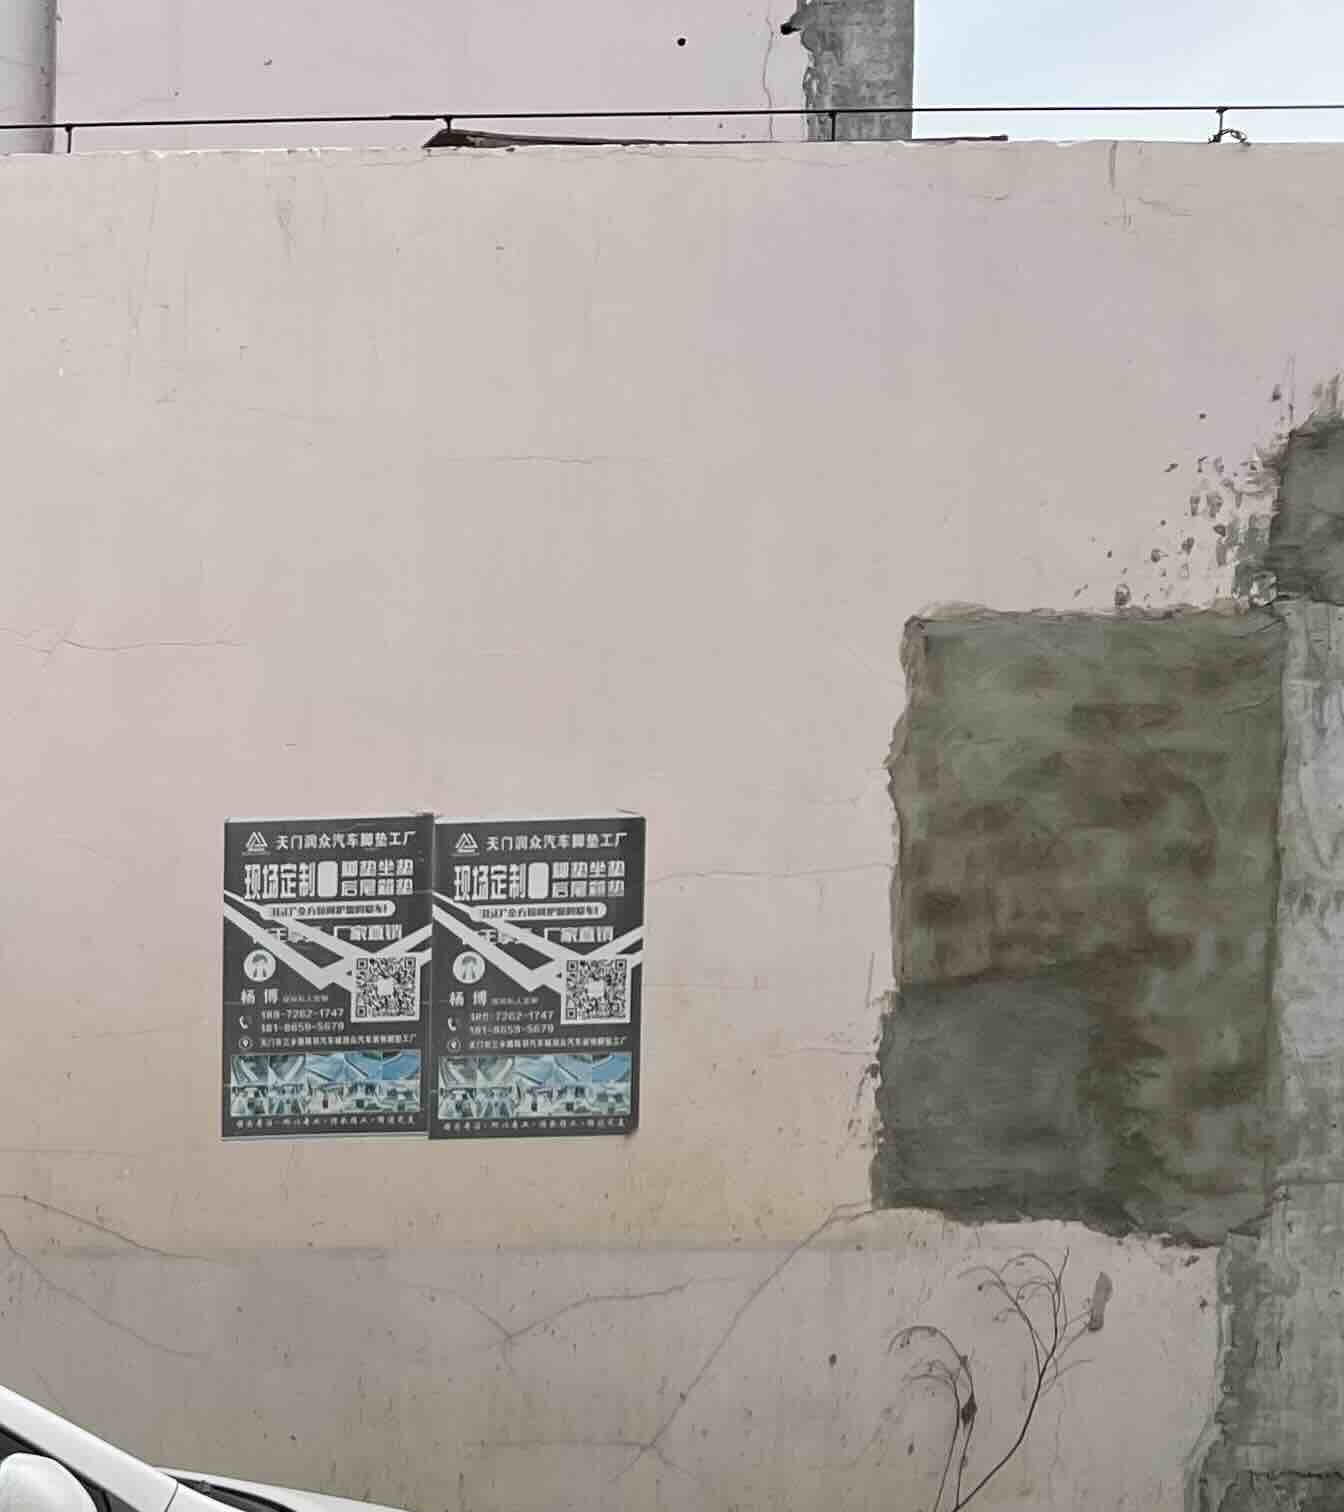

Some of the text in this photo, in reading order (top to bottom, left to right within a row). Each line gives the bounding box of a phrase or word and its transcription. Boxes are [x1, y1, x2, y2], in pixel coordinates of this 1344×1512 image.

[275, 830, 417, 850] 天门润众汽车脚垫工厂
[485, 832, 628, 851] 天门润众汽车脚垫工厂
[244, 861, 316, 900] 现场定制
[453, 863, 527, 901] 现场定制
